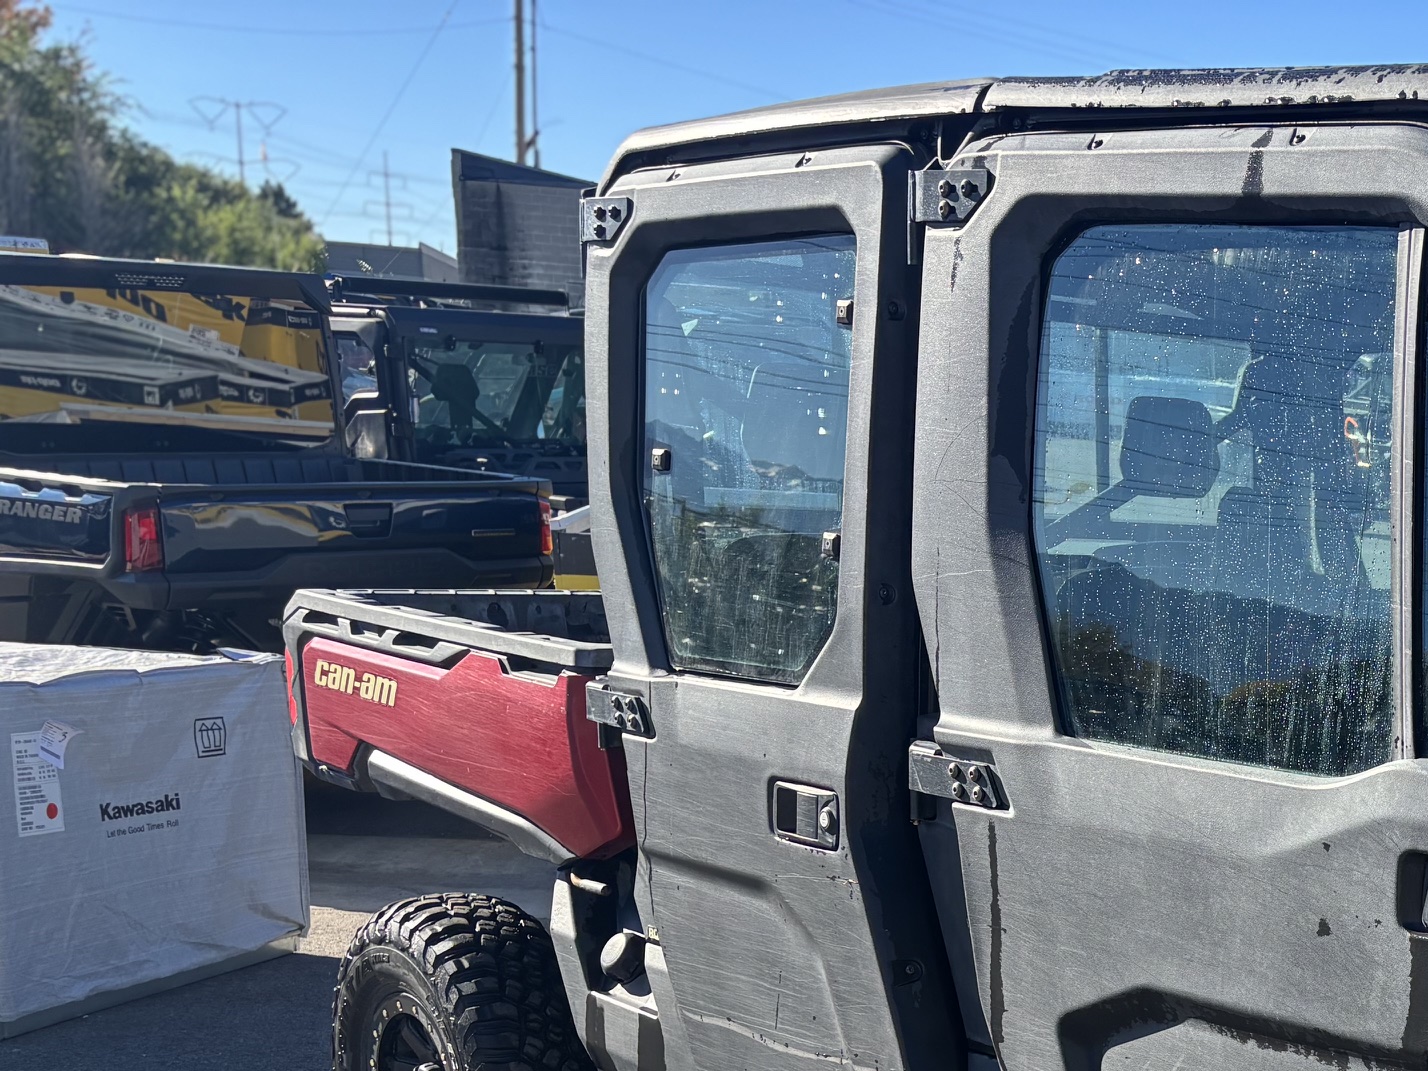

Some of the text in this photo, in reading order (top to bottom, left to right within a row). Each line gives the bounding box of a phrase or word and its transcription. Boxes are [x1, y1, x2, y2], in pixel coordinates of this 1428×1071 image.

[314, 659, 398, 708] can-am
[99, 792, 181, 822] Kawasaki
[106, 819, 179, 838] Let the Good Times Roll
